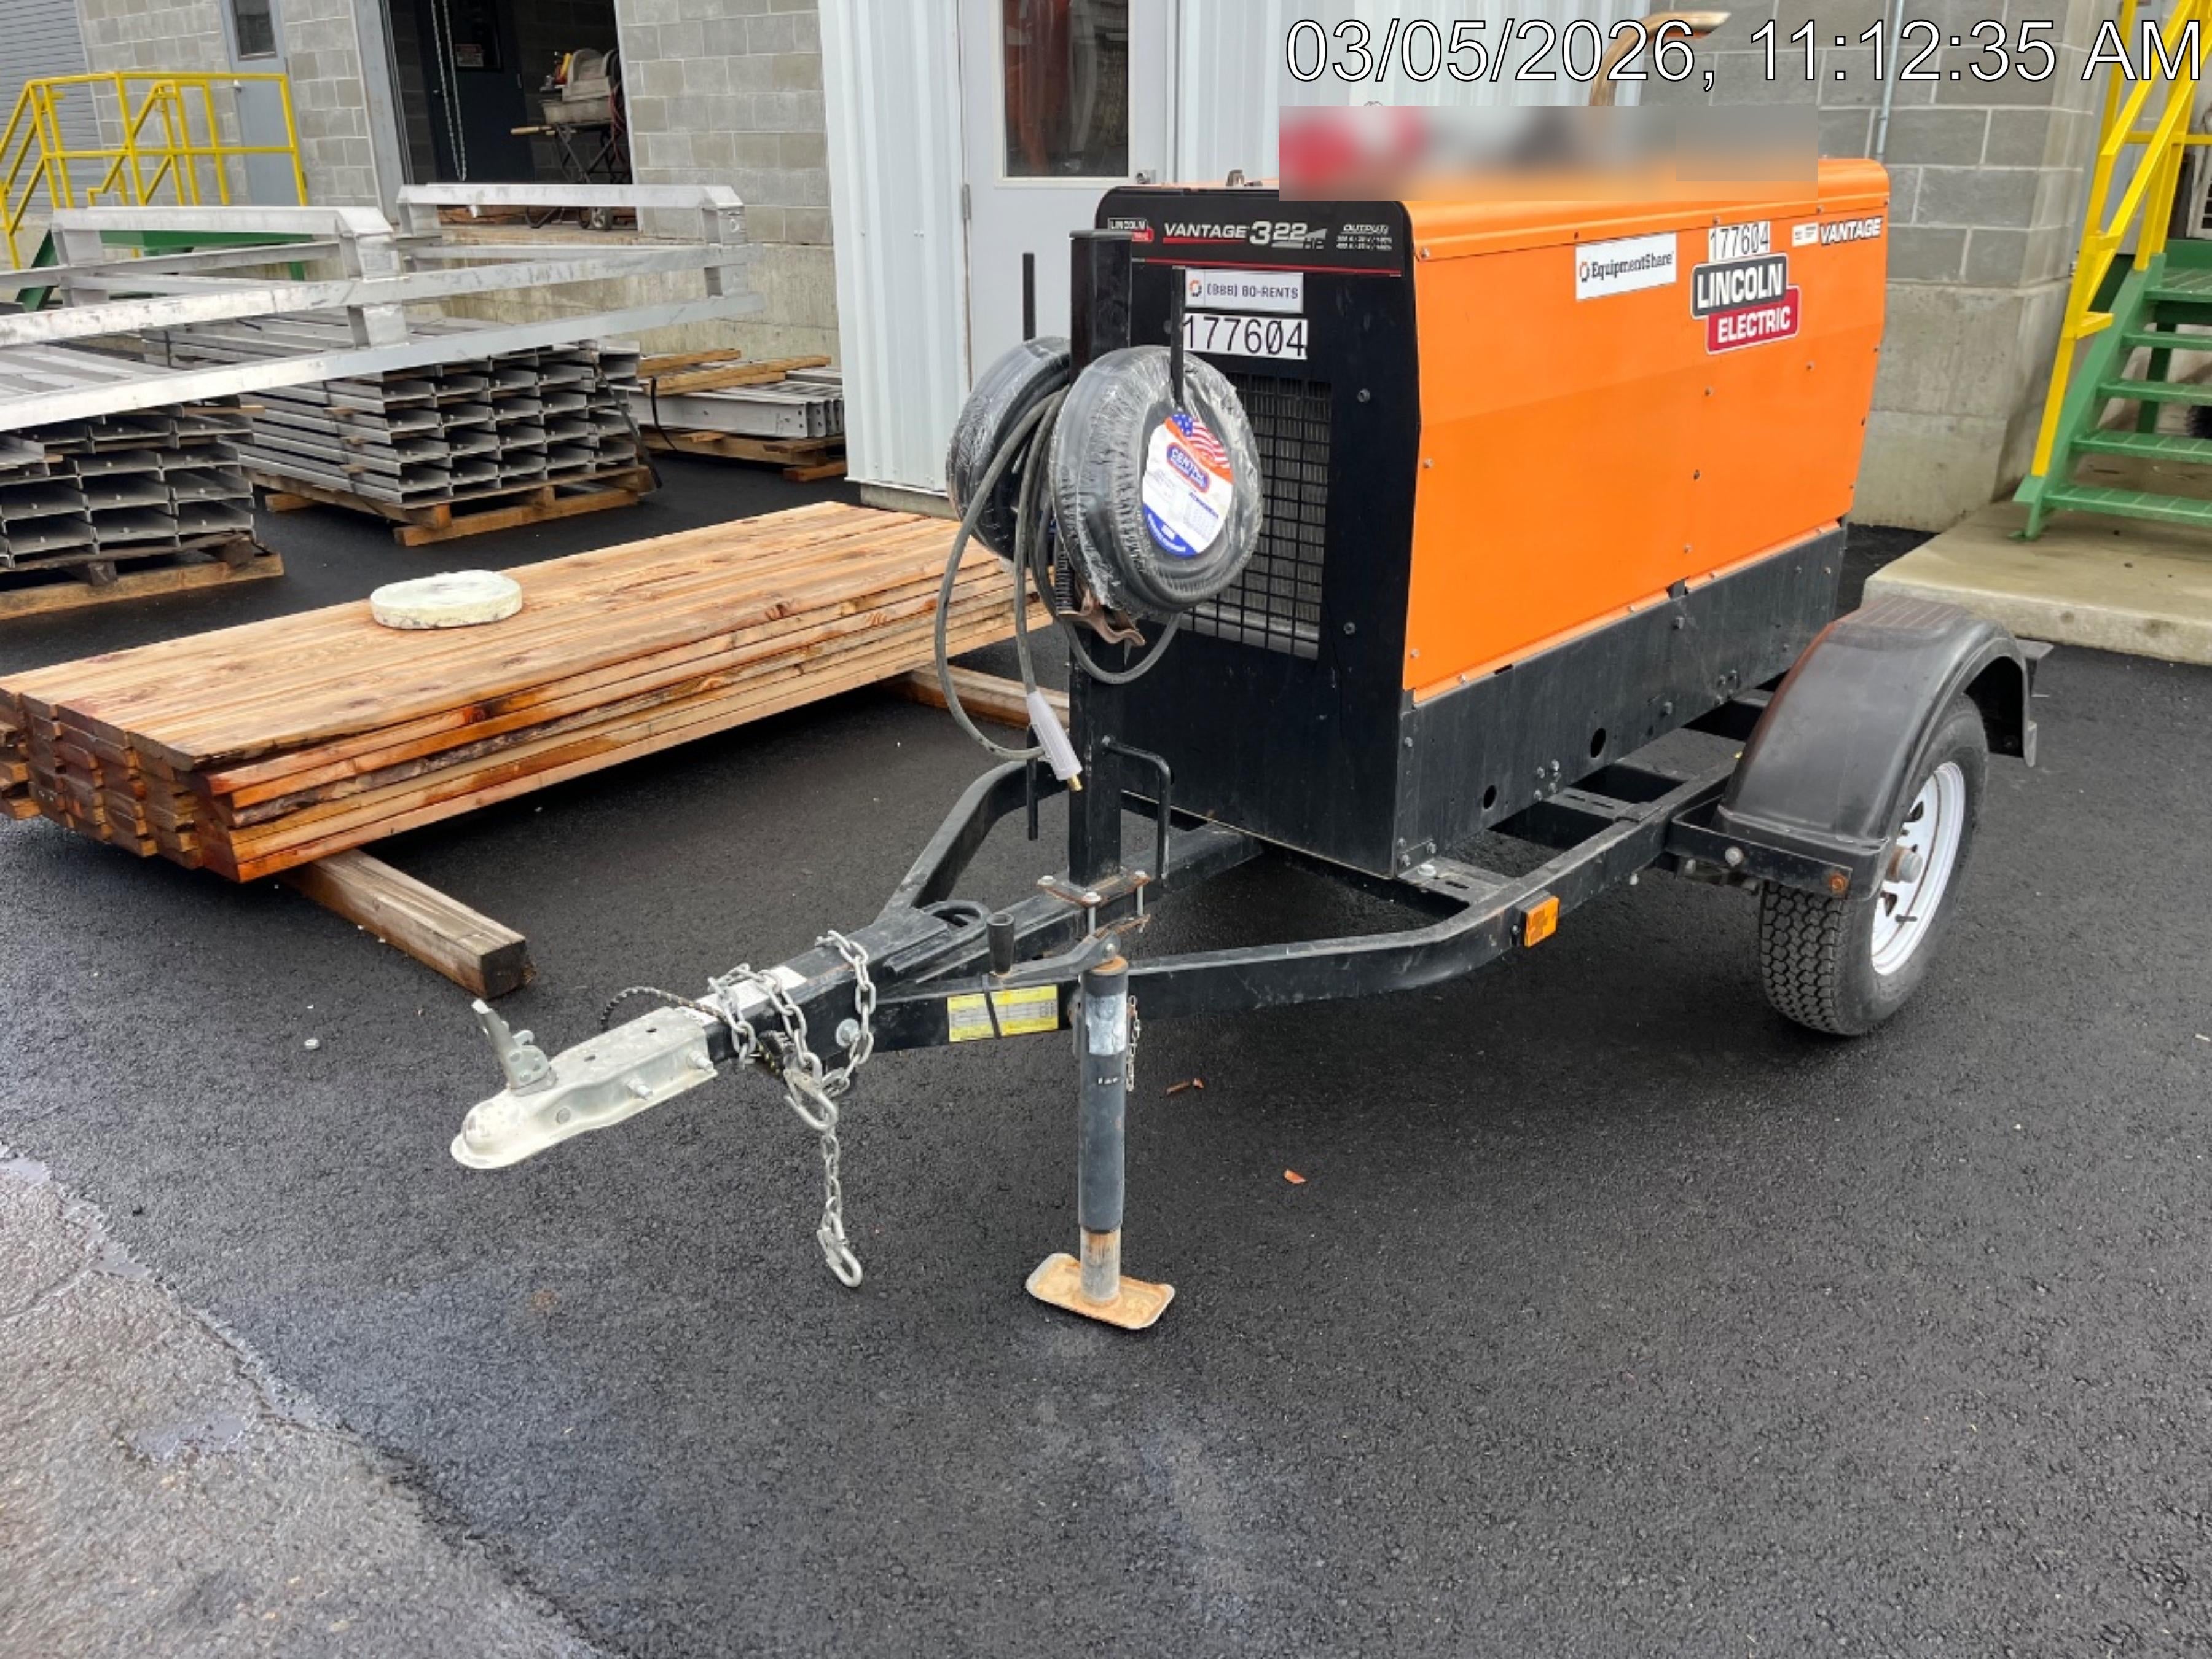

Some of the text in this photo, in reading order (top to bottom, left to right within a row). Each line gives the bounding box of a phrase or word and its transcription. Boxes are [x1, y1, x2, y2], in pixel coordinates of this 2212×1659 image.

[1164, 222, 1247, 238] VANTAGE
[1249, 220, 1308, 245] 322
[1710, 221, 1768, 261] 177604
[1820, 216, 1883, 246] VANTAGE
[1591, 253, 1673, 281] EquipmentShare
[1206, 283, 1237, 297] (888)
[1696, 263, 1783, 309] LINCOLN
[1183, 315, 1307, 357] 177604
[1717, 305, 1790, 344] ELECTRIC
